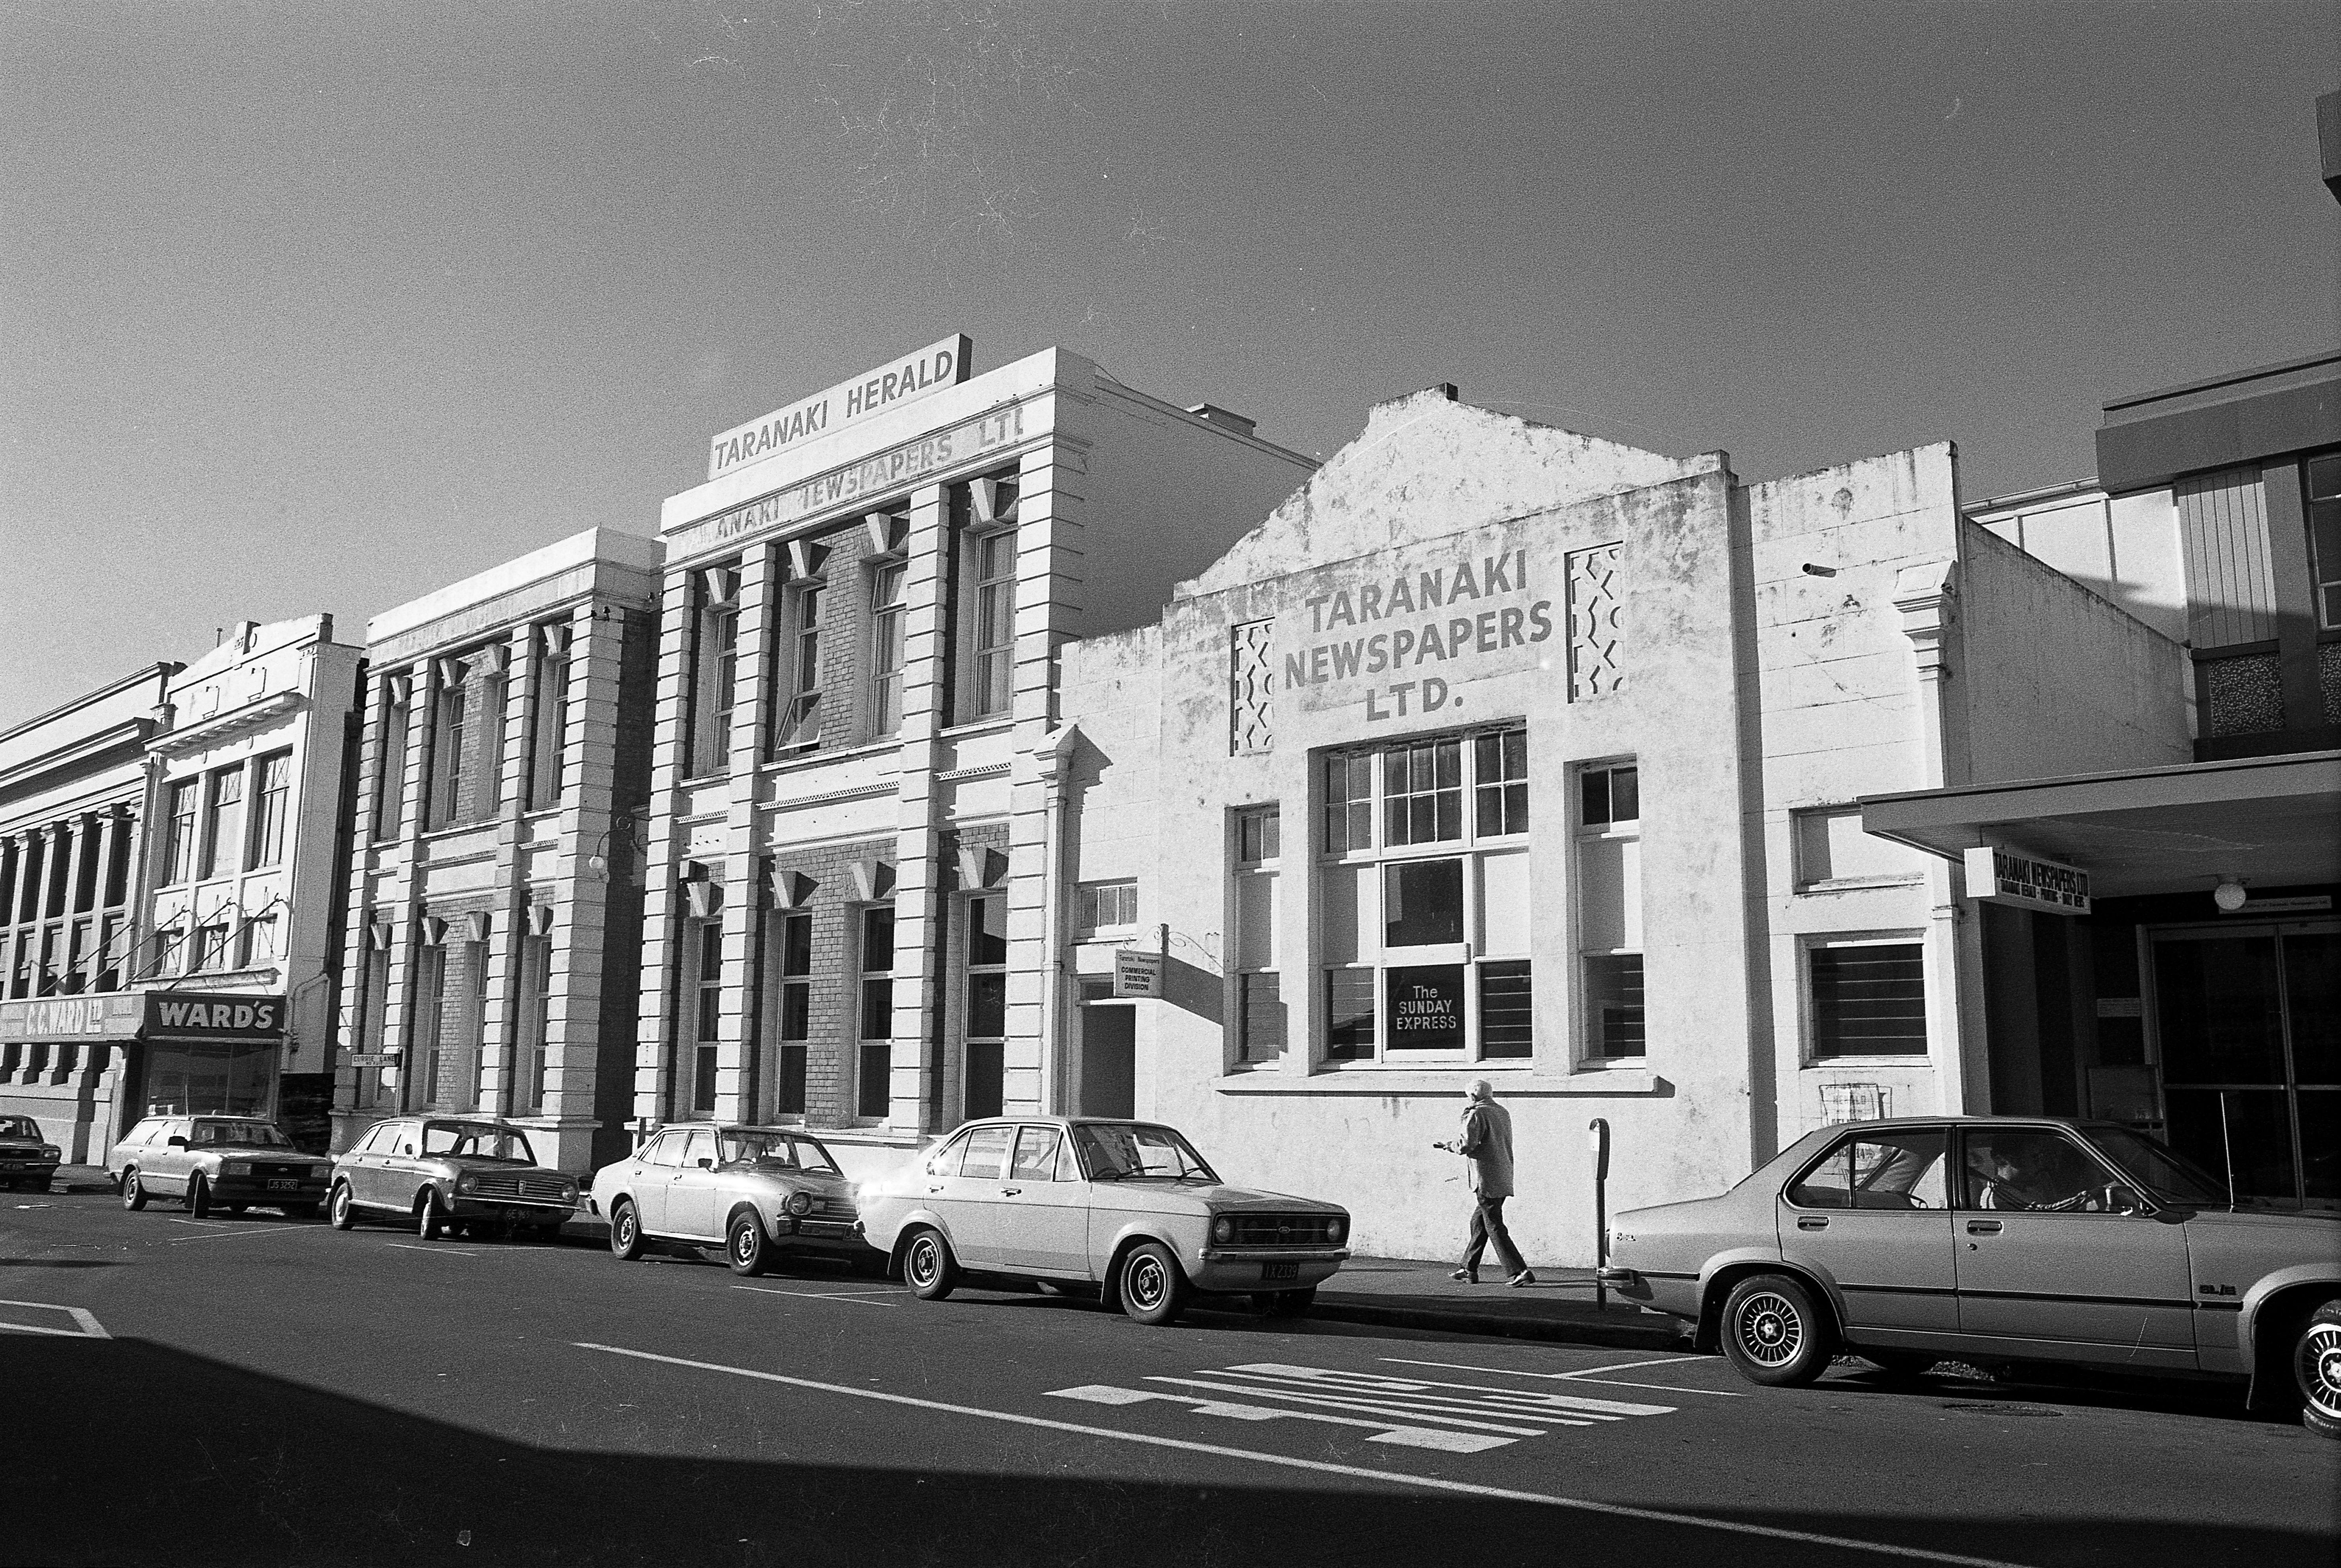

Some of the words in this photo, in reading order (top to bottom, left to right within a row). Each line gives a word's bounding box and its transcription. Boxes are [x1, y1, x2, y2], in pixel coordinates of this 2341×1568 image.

[715, 400, 828, 470] TARANAKI
[847, 351, 952, 418] HERALD
[1305, 549, 1526, 633] TARANAKI
[1285, 600, 1552, 689] NEWSPAPERS
[1366, 677, 1463, 722] LTD.
[1993, 852, 2029, 885] TARANAKI
[2031, 860, 2076, 895] NEWSPAPERS
[1121, 966, 1156, 975] COMMERCIAL
[1399, 999, 1452, 1014] SUNDAY
[1413, 985, 1438, 998] The
[159, 1000, 275, 1029] WARD'S
[1396, 1016, 1457, 1030] EXPRESS
